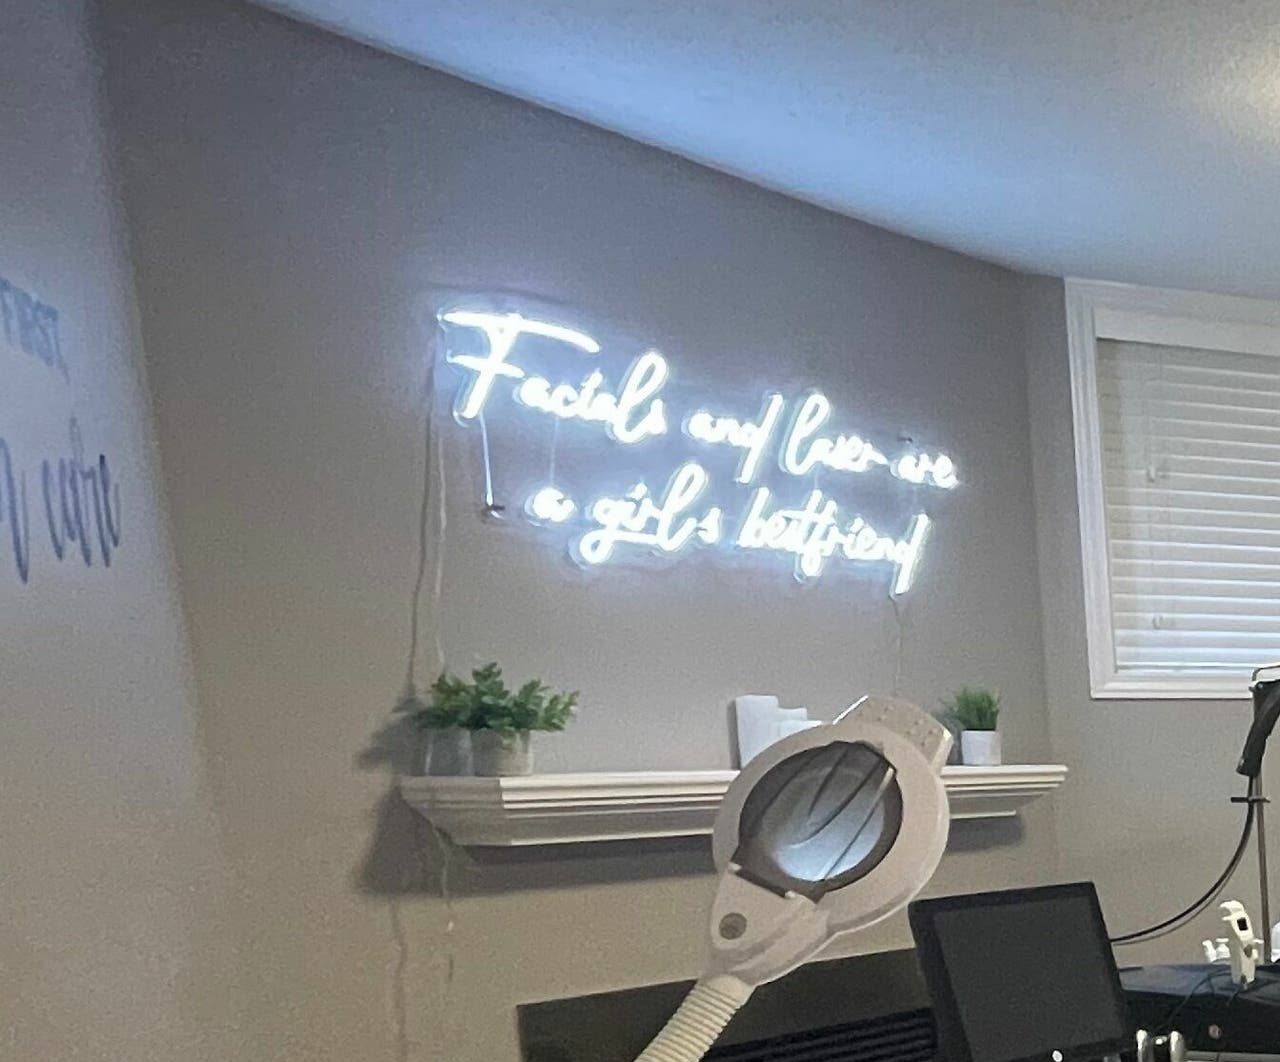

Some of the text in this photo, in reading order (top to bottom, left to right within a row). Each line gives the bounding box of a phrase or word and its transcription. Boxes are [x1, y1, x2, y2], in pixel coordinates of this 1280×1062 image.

[438, 312, 668, 443] Facials
[684, 392, 783, 484] and
[890, 453, 958, 489] are
[528, 487, 576, 524] a
